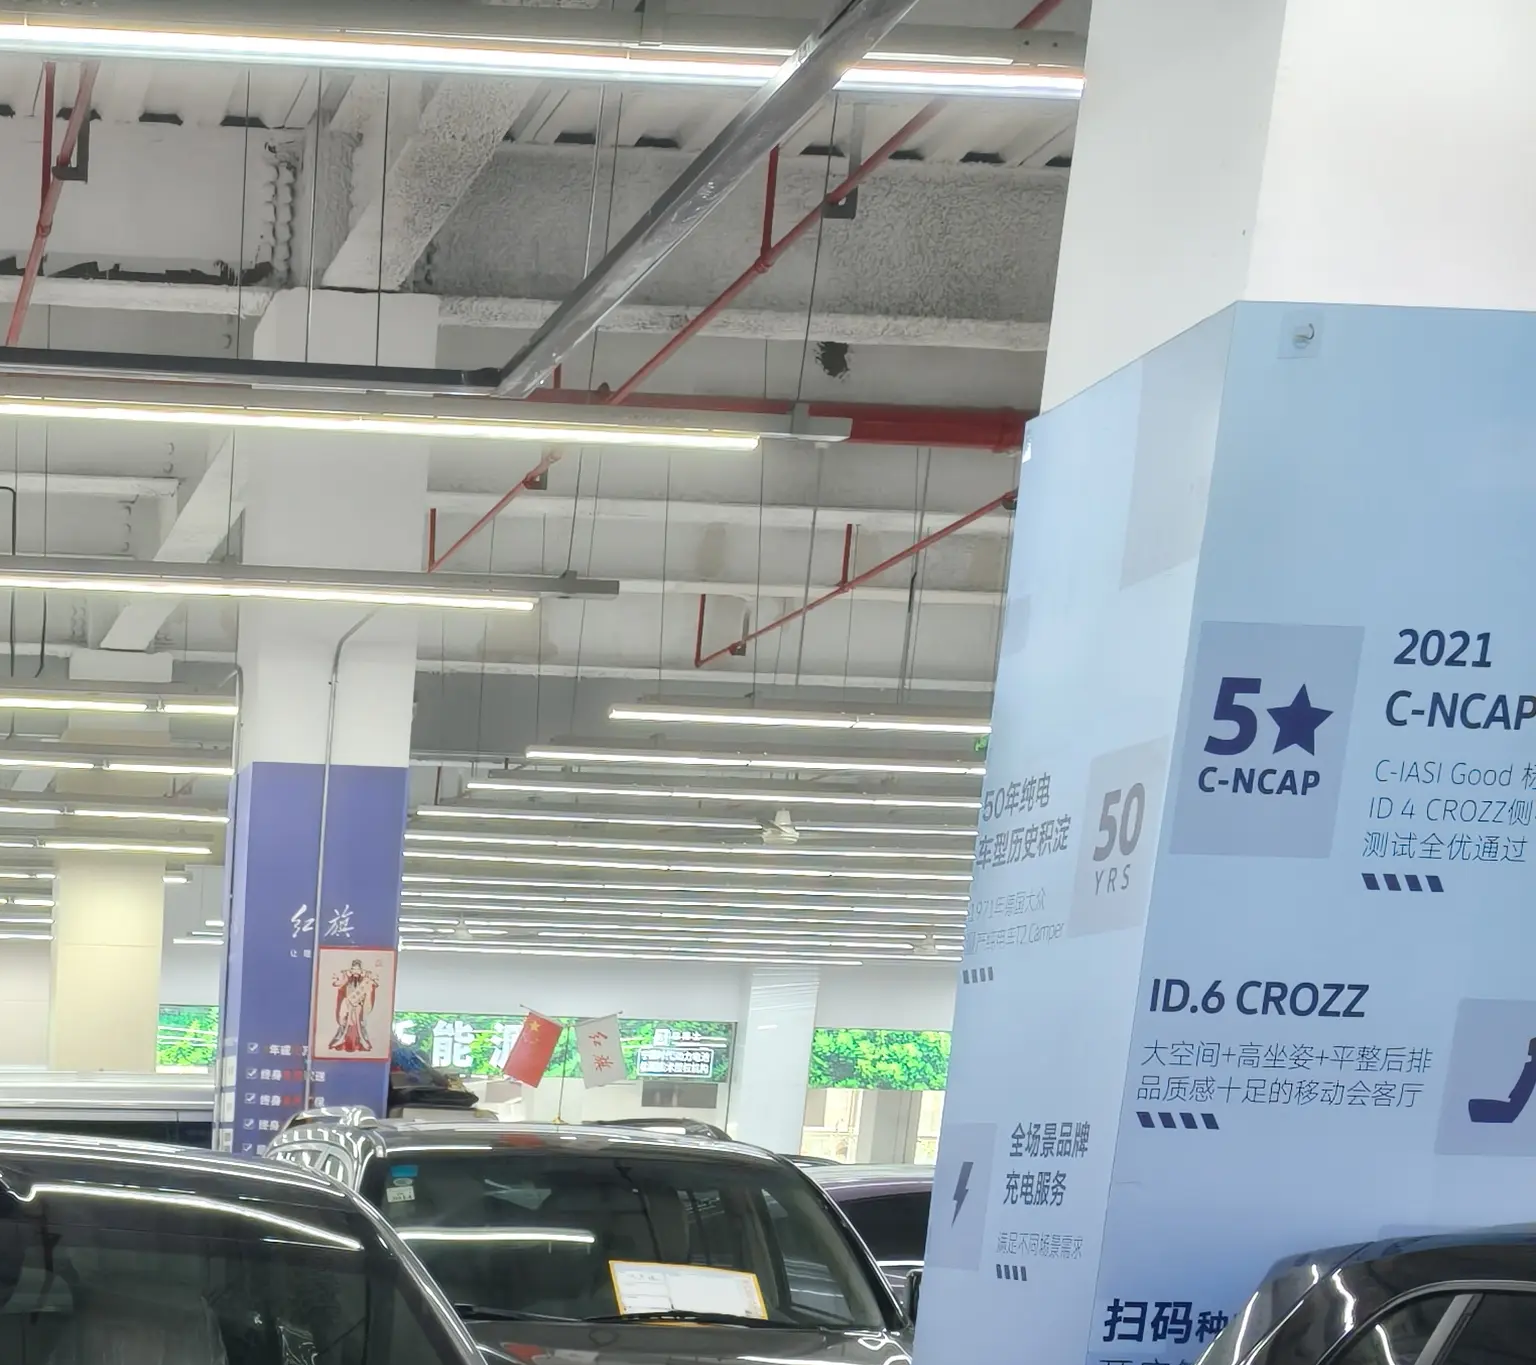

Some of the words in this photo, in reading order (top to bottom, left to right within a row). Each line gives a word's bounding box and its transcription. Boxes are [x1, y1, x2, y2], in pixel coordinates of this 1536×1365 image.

[1393, 628, 1493, 668] 2021
[1204, 677, 1262, 756] 5
[1385, 690, 1536, 730] C-NCAP
[1198, 766, 1321, 796] C-NCAP
[1375, 759, 1443, 784] C-IASI
[1451, 762, 1514, 787] Good
[983, 771, 1052, 822] 50年纯电
[1401, 798, 1416, 820] 4
[1092, 782, 1146, 862] 50
[976, 813, 1072, 870] 车型历史积淀
[1362, 831, 1529, 862] 测试全优通过
[1094, 864, 1132, 896] YRS
[290, 903, 355, 938] 红旗
[1149, 978, 1226, 1014] ID.6
[1236, 980, 1370, 1018] CROZZ
[1141, 1040, 1433, 1075] 大空间+高坐姿+平整后排
[1136, 1075, 1425, 1108] 品质感十足的移动会客厅
[1009, 1121, 1091, 1158] 全场景品牌
[1004, 1168, 1067, 1206] 充电服务
[1103, 1298, 1236, 1345] 扫码种
